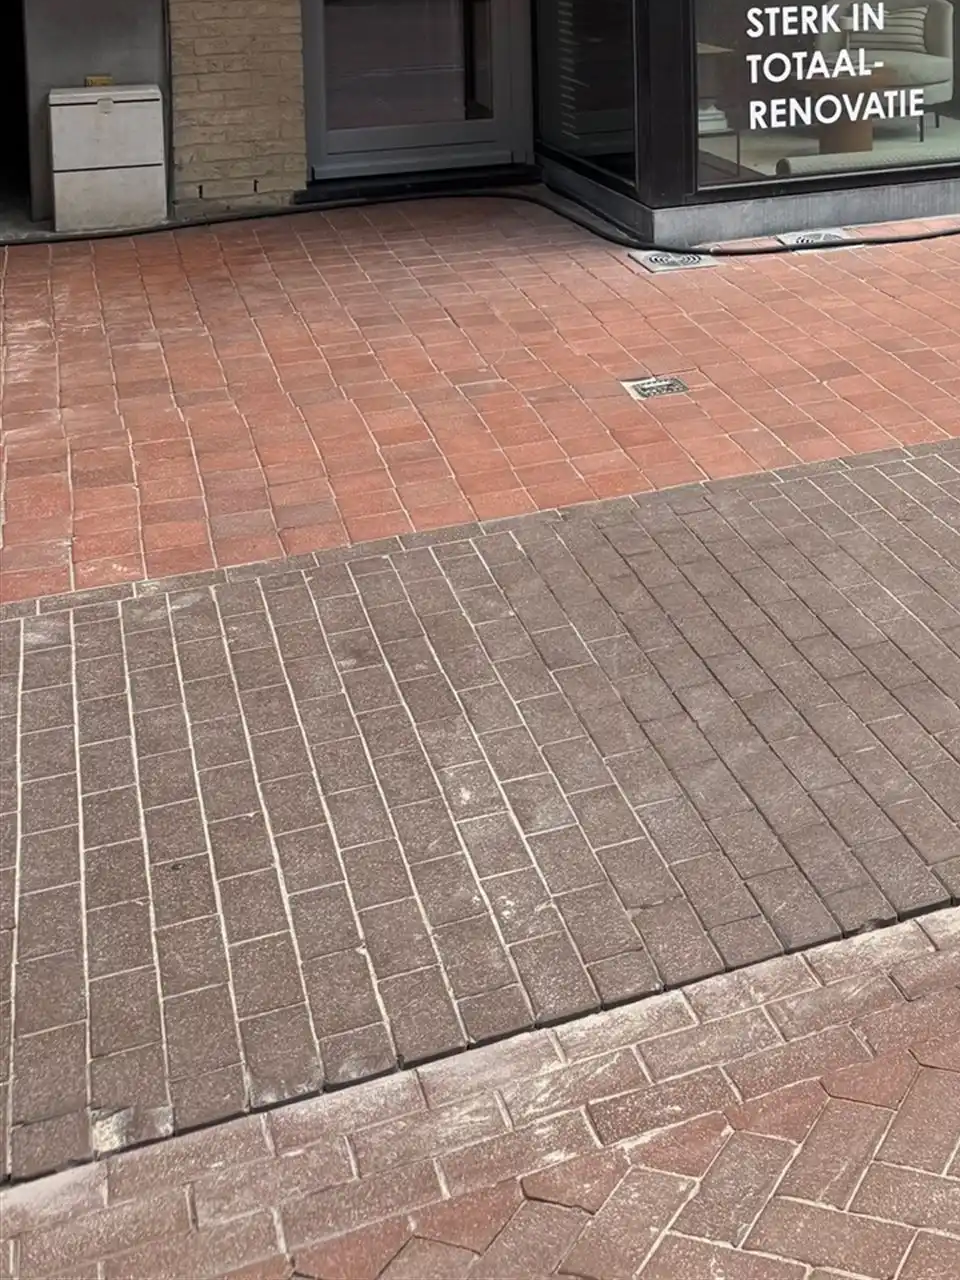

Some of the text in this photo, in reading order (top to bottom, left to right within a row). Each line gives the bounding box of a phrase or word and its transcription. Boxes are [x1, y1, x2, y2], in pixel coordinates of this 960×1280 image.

[746, 2, 885, 38] STERK IN
[746, 48, 885, 83] TOTAAL-
[749, 88, 925, 130] RENOVATIE
